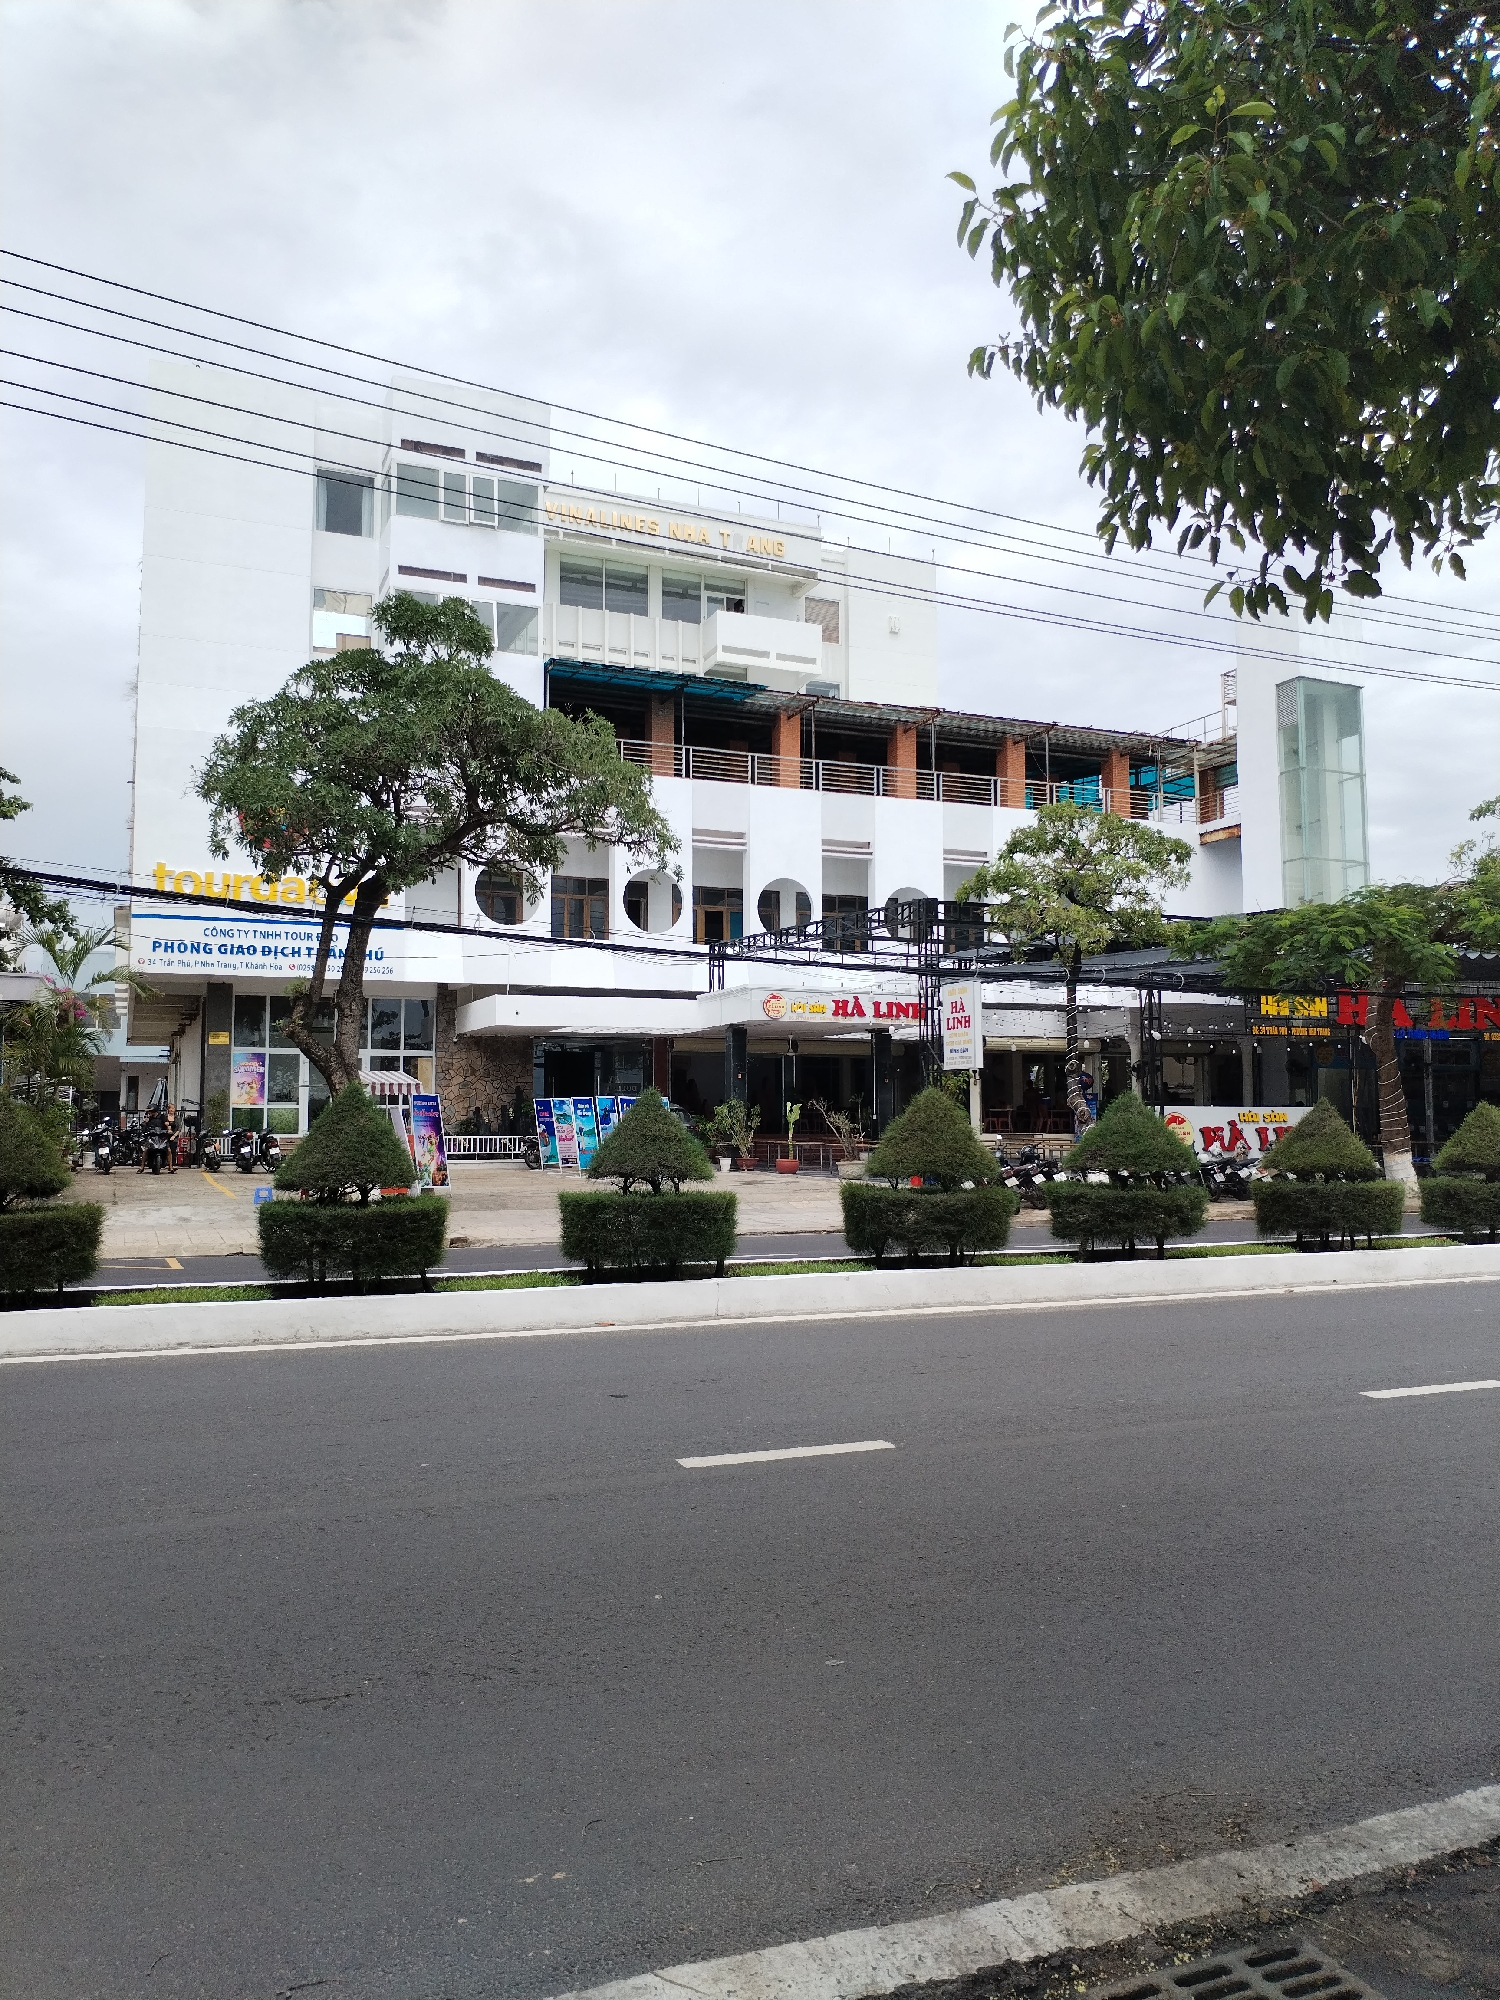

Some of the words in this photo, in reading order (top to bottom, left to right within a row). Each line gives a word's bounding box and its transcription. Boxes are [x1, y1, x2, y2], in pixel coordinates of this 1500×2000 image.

[545, 501, 660, 536] VINALINES
[669, 522, 711, 544] NHA
[719, 529, 786, 557] TANG
[203, 926, 235, 938] CÔNG
[236, 929, 251, 939] TY
[252, 930, 281, 940] TNHH
[284, 931, 314, 942] TOUR
[217, 943, 258, 956] GIAO
[832, 995, 867, 1018] HÀ
[950, 996, 966, 1015] HÀ
[946, 1014, 971, 1031] LINH
[1238, 1110, 1260, 1123] HẢI
[1263, 1110, 1289, 1123] SẢN
